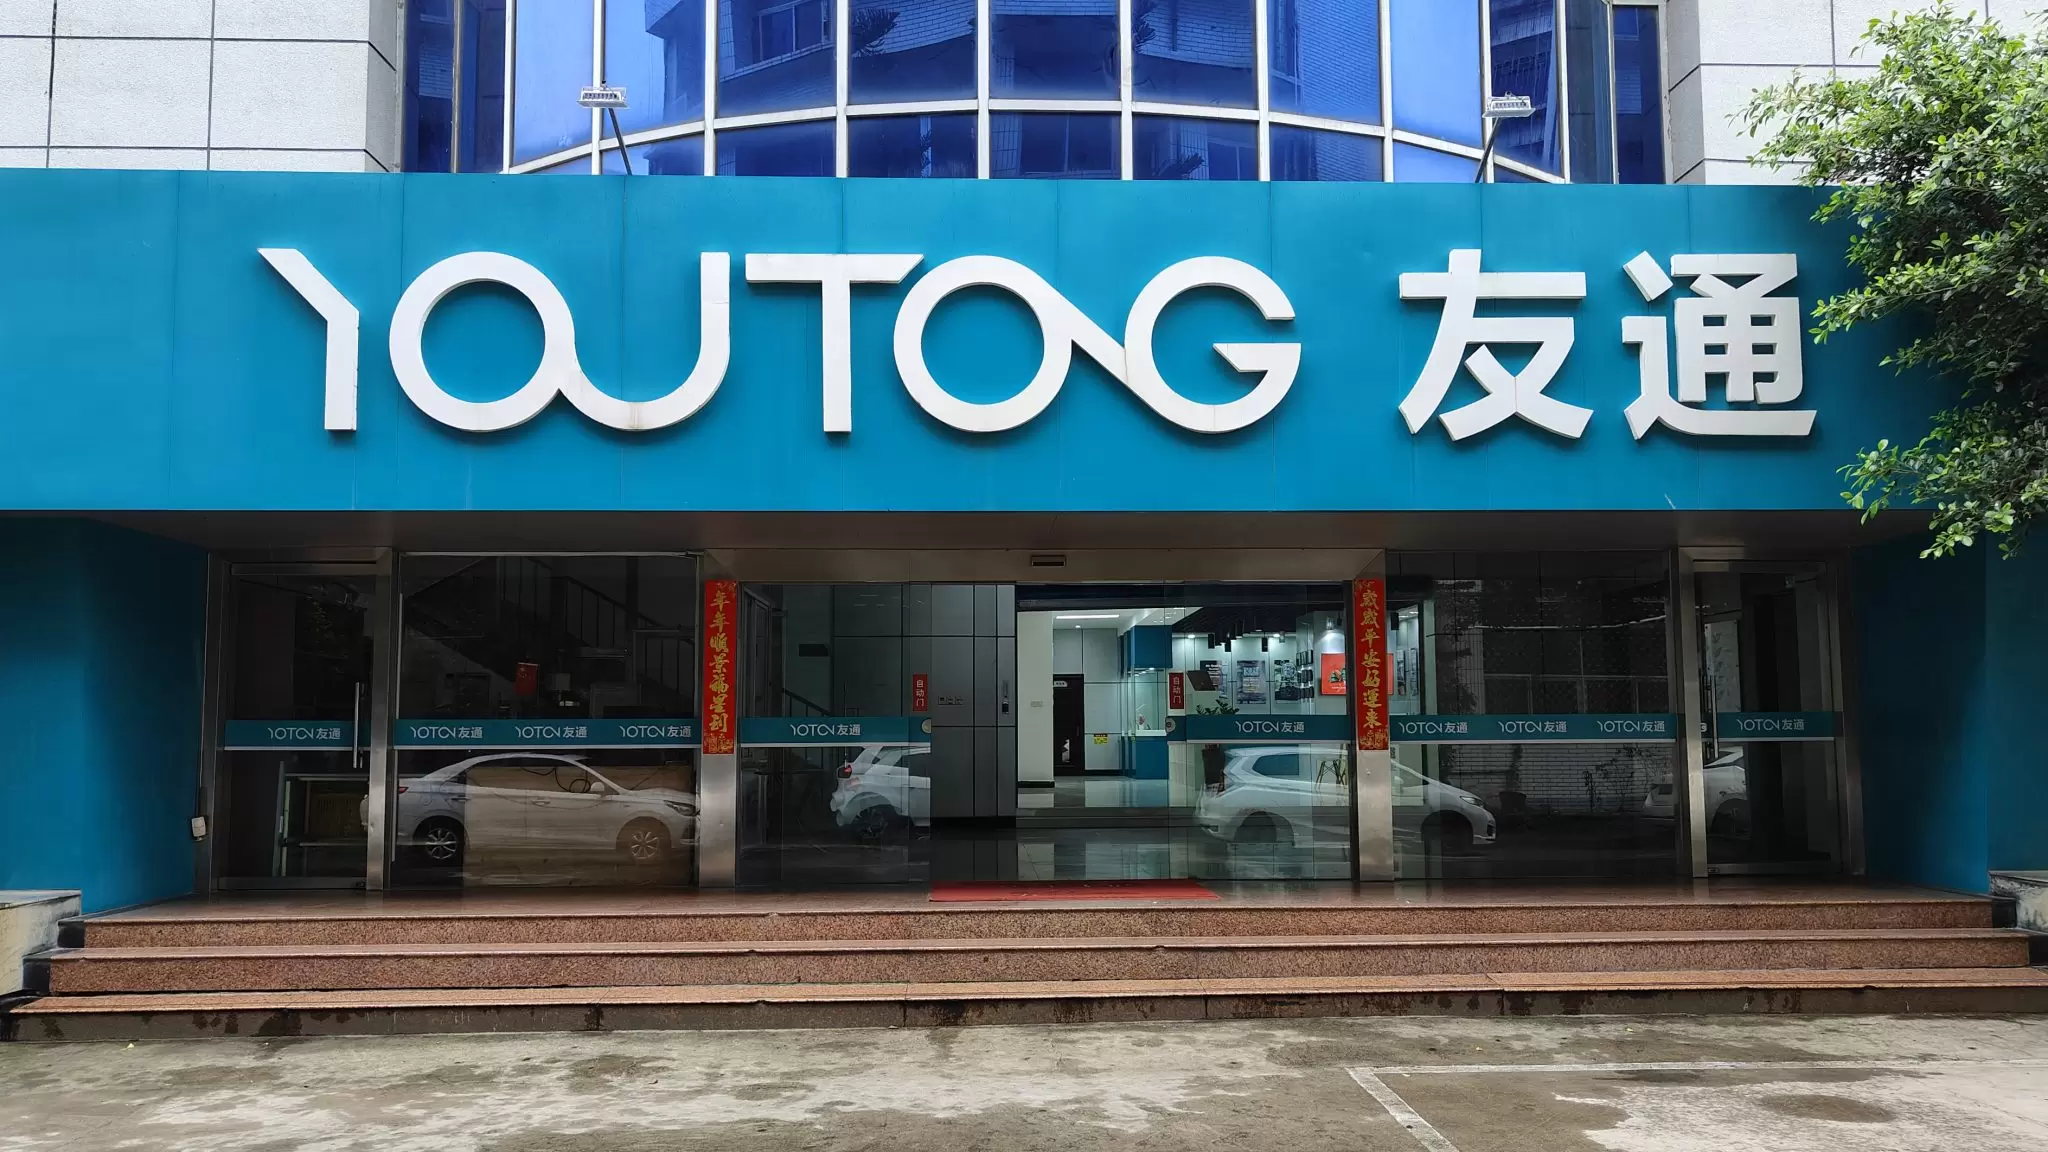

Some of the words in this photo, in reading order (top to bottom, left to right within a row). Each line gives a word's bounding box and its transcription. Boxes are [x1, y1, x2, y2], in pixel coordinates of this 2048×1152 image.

[1399, 249, 1830, 440] 友通
[837, 724, 860, 735] 友通
[1282, 721, 1304, 732] 友通
[1445, 722, 1467, 733] 友通
[1544, 721, 1566, 732] 友通
[1643, 721, 1664, 732] 友通
[1782, 719, 1804, 730] 友通
[316, 728, 340, 739] 友通
[459, 727, 482, 738] 友通
[563, 727, 586, 737] 友通
[668, 726, 690, 737] 友通
